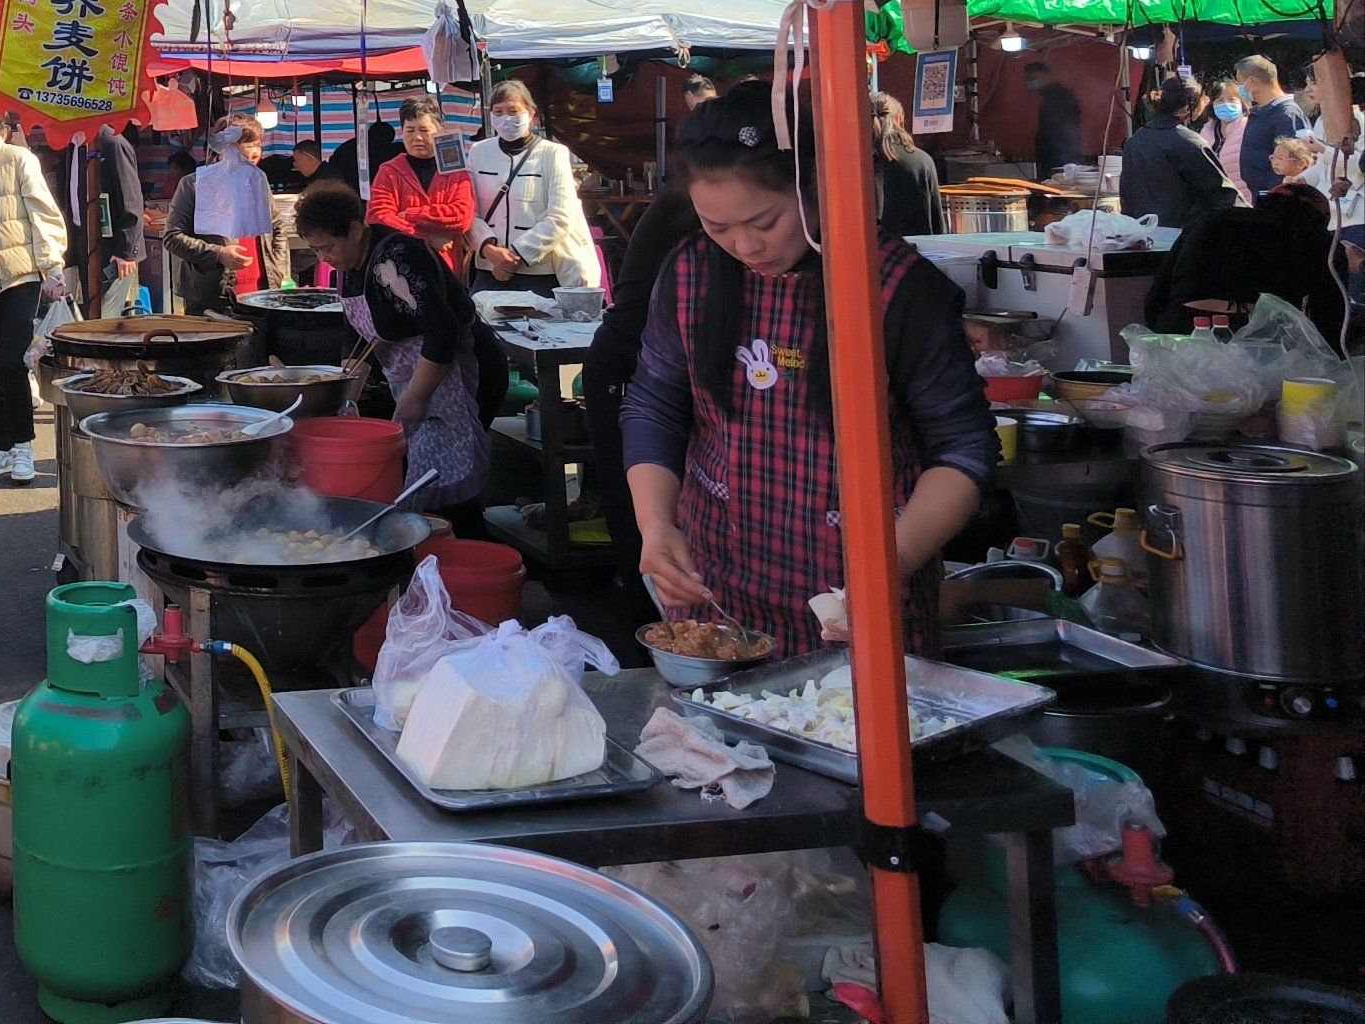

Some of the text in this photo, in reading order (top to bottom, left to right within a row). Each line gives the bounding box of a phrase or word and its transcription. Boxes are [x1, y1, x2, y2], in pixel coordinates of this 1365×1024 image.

[35, 89, 114, 113] 13735696528
[772, 345, 802, 358] Sweet
[778, 357, 808, 370] Melod
